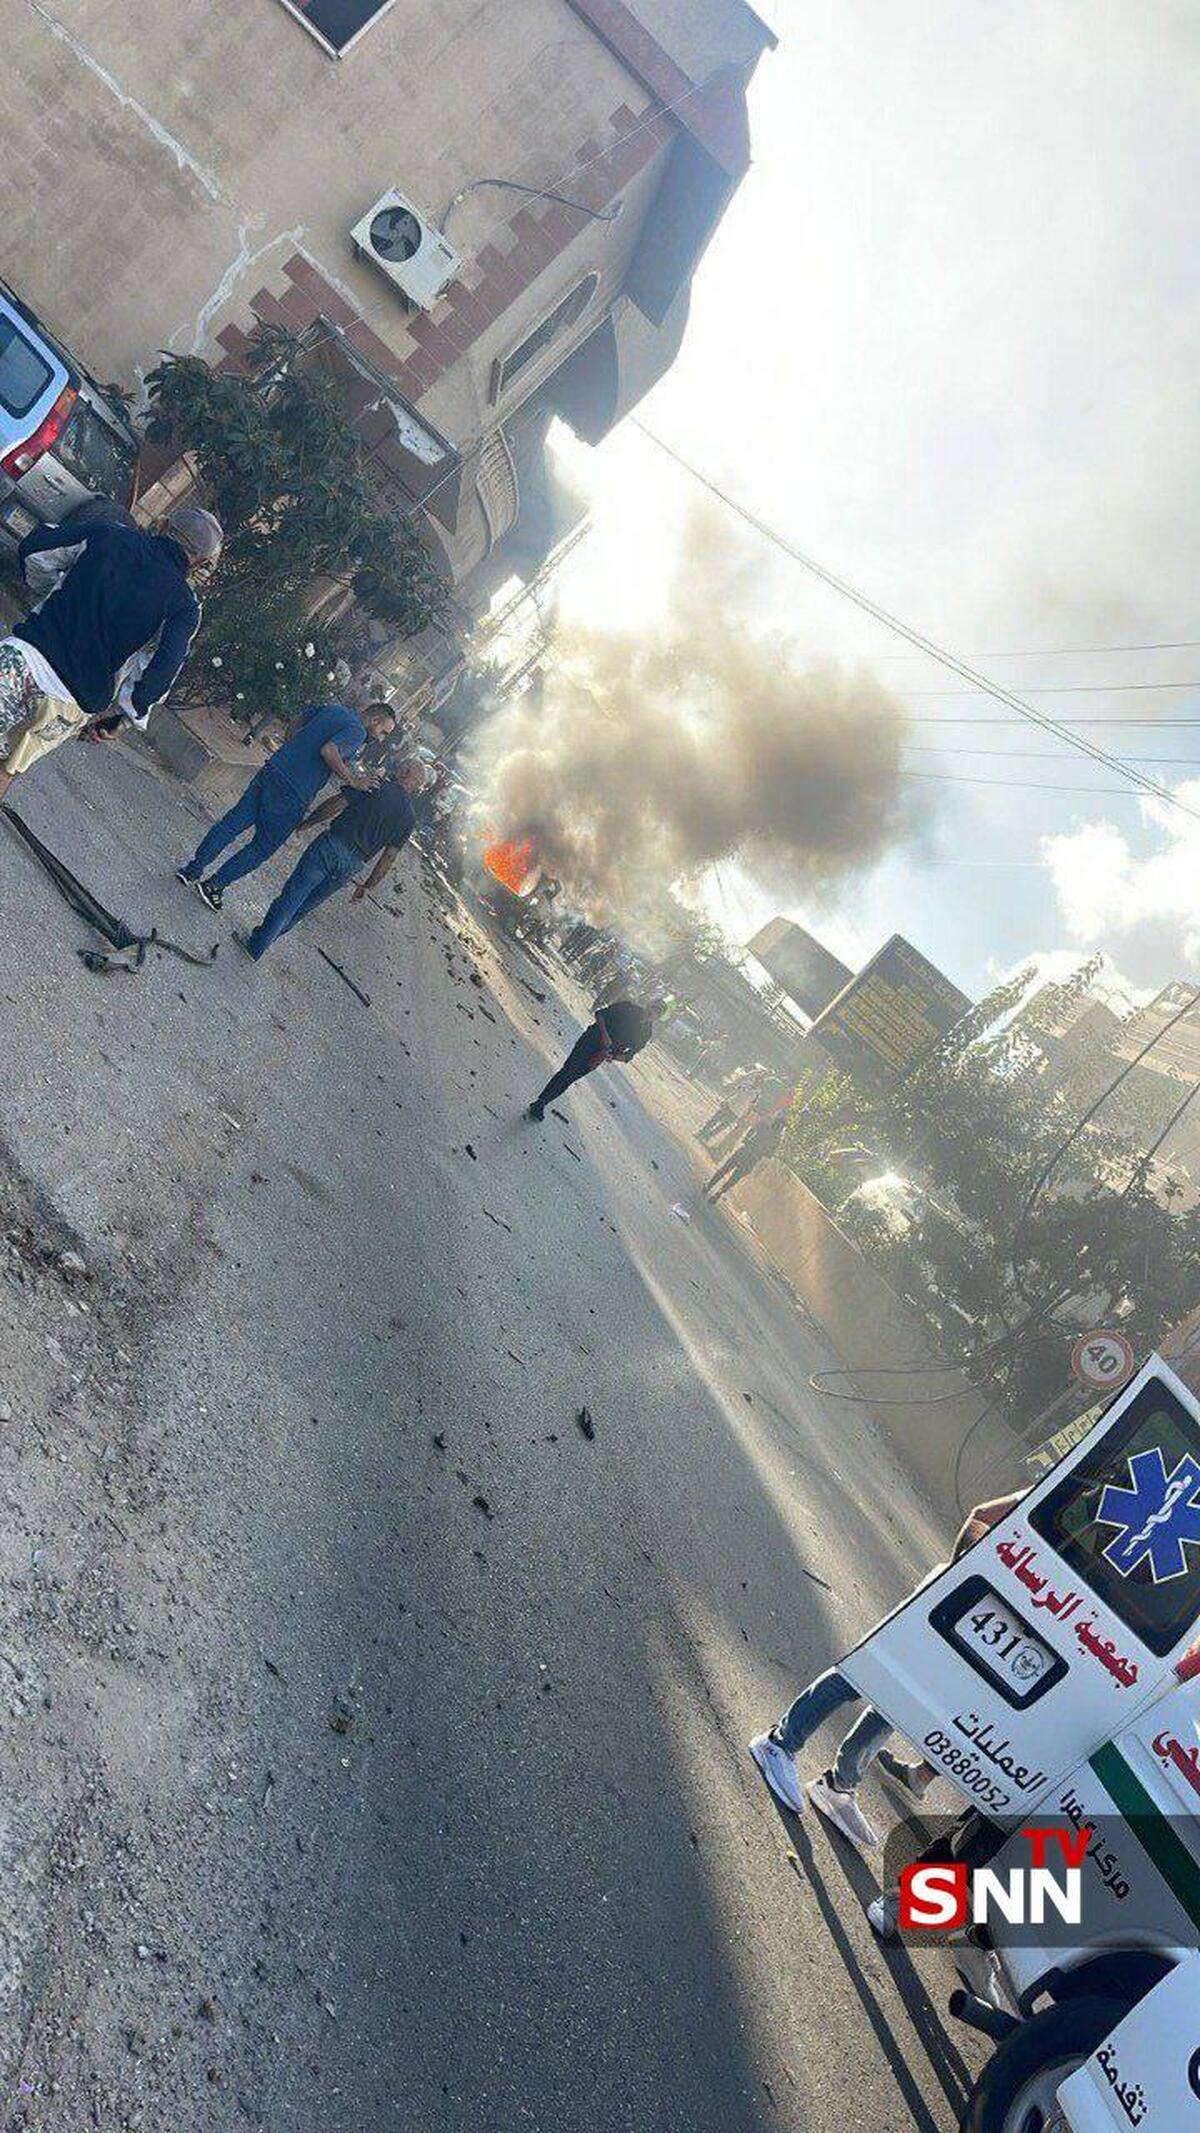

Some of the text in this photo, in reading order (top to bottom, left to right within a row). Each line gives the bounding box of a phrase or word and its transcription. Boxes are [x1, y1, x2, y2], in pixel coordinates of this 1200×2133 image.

[1087, 1345, 1117, 1373] 40
[996, 1530, 1084, 1622] الرسالة
[971, 1612, 1022, 1661] 431
[1074, 1610, 1138, 1690] جمعية
[923, 1730, 1011, 1812] 03880052
[952, 1713, 1048, 1793] العمليات
[1097, 2043, 1147, 2127] تقدمة
